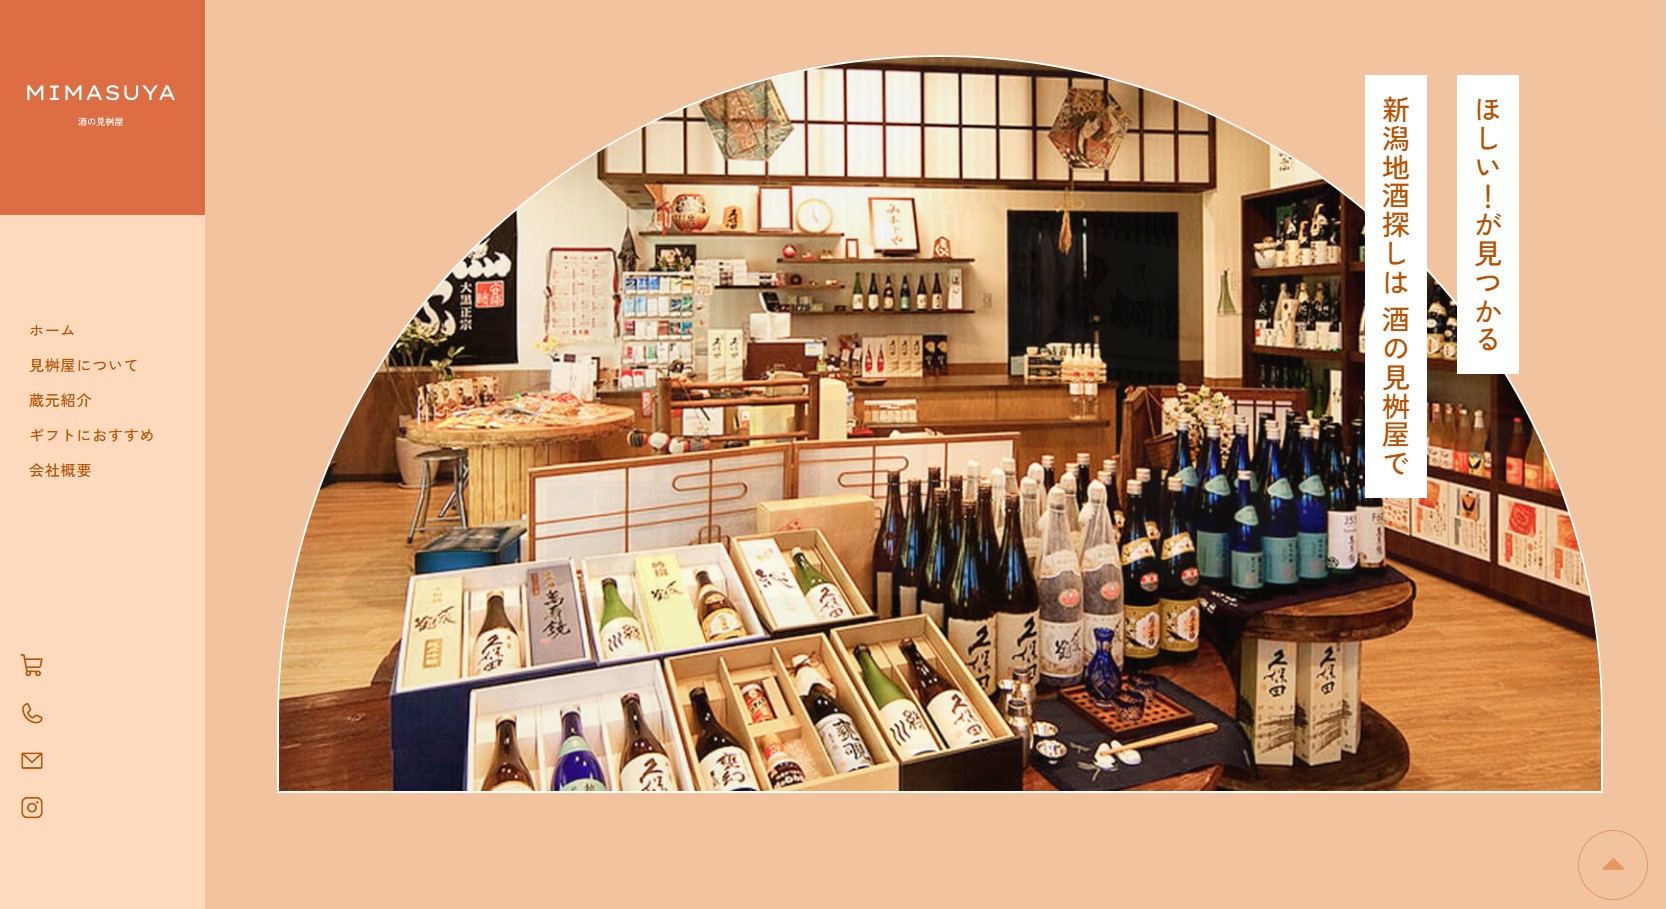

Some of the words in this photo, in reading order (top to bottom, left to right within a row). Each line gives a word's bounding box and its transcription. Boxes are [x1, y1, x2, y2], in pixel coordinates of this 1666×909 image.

[459, 281, 473, 331] 大黒正宗
[1262, 648, 1289, 698] 久保田
[1316, 646, 1337, 695] 久保田
